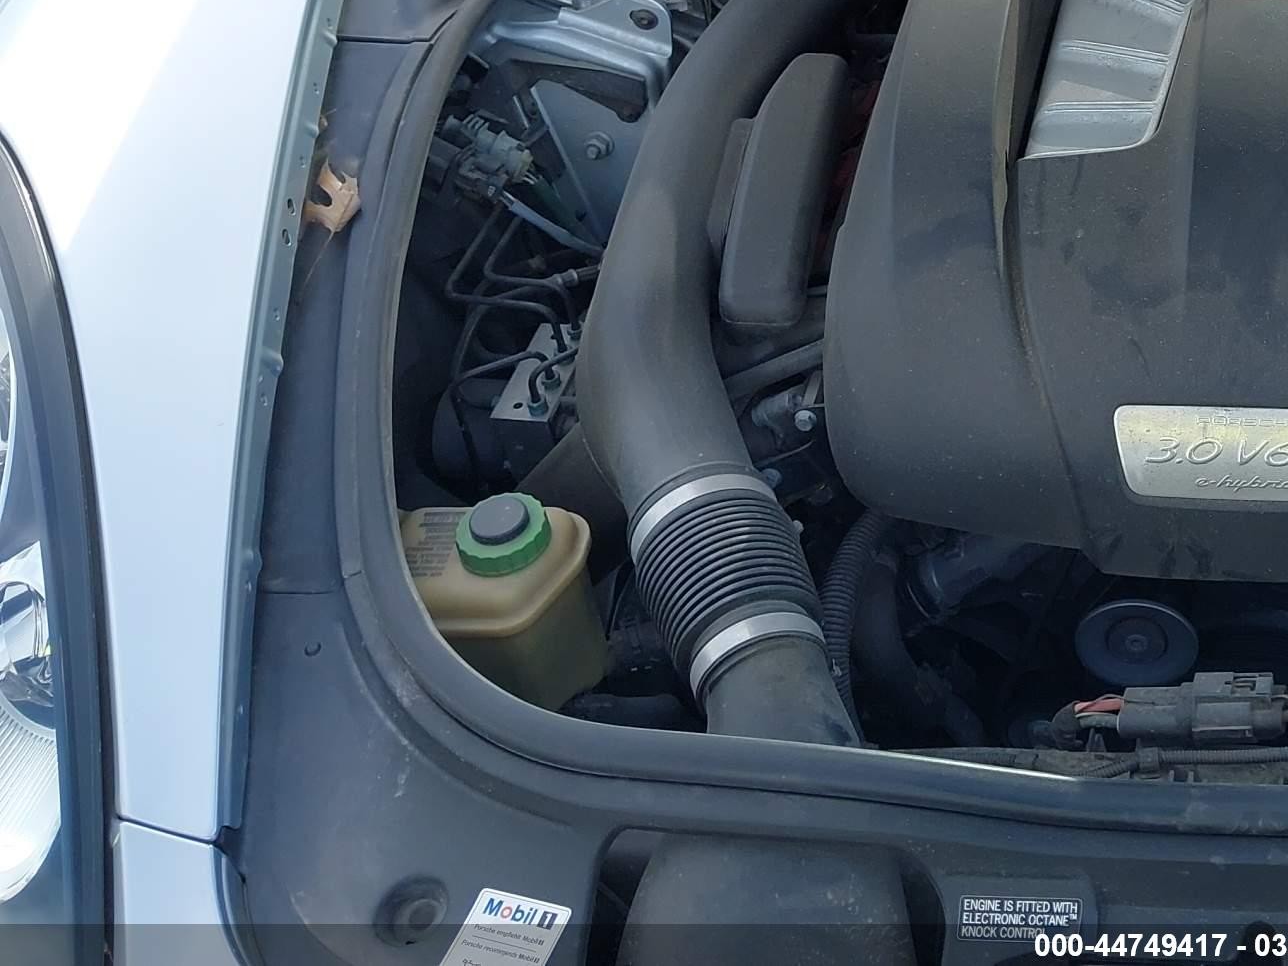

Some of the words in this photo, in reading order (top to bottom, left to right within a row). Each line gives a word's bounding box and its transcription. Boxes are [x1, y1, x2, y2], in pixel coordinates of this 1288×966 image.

[1145, 436, 1223, 465] 3.0
[483, 897, 538, 925] Mobil
[963, 899, 1001, 911] ENGINE
[1003, 900, 1014, 911] IS
[1016, 901, 1050, 913] FITTED
[1053, 902, 1078, 914] WITH
[962, 912, 1025, 925] ELECTRONIC
[961, 925, 997, 938] KNOCK
